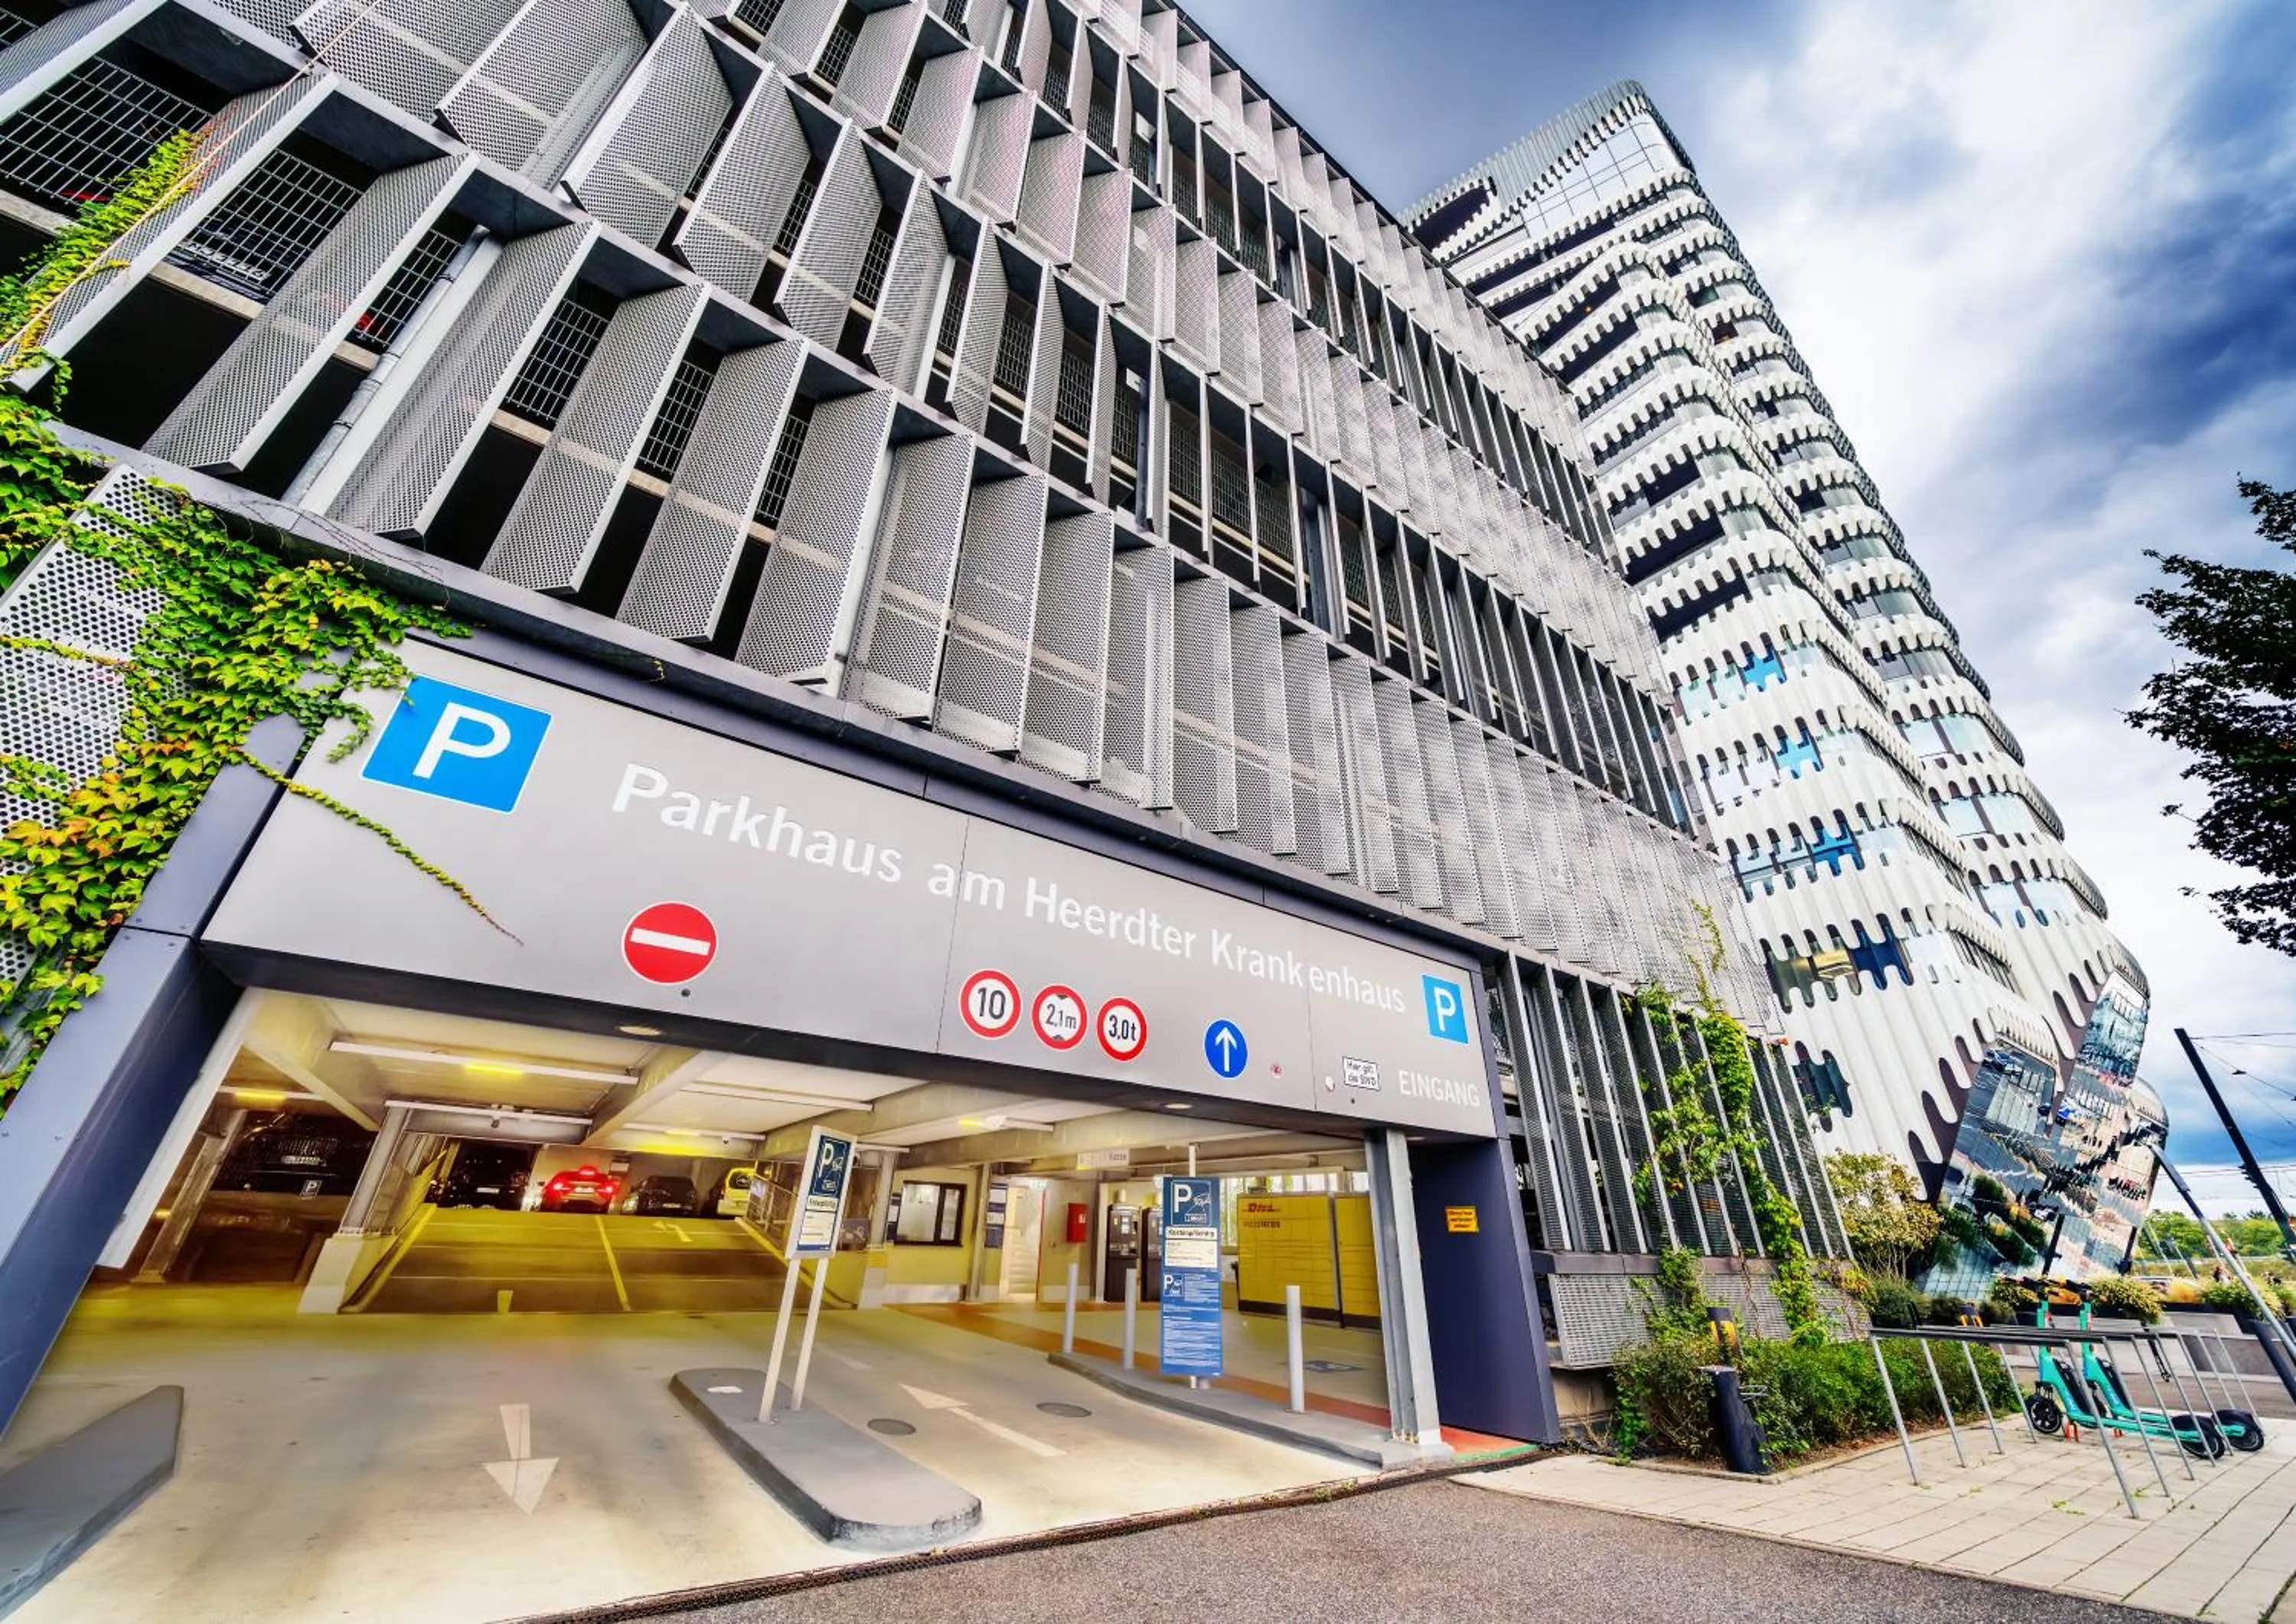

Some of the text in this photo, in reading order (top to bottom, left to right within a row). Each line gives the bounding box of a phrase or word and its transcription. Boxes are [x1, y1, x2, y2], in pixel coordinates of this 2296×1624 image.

[412, 701, 512, 779] P
[612, 762, 1407, 1014] Parkhaus am Heerdter Krankenhaus
[977, 986, 1007, 1020] 10
[1433, 986, 1456, 1032] P
[1398, 1070, 1481, 1107] EINGANG
[818, 1143, 834, 1178] P
[1173, 1184, 1192, 1213] P
